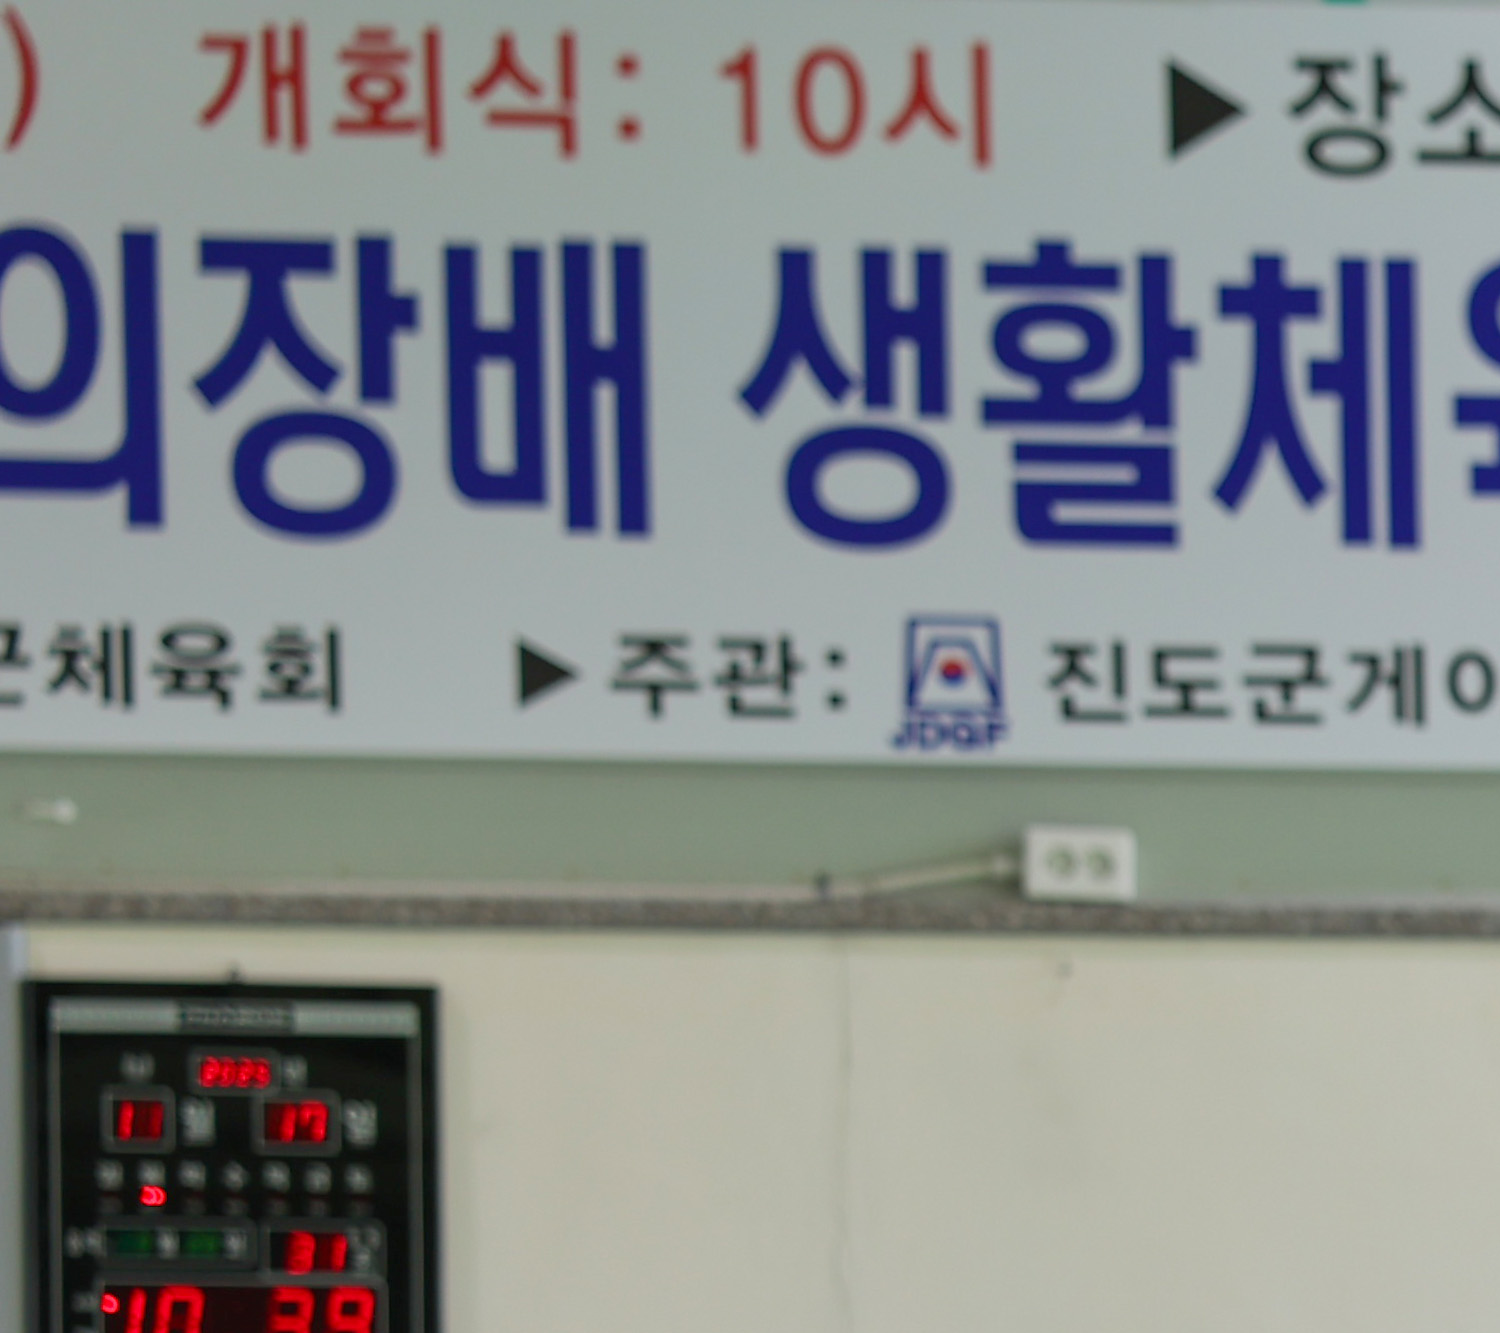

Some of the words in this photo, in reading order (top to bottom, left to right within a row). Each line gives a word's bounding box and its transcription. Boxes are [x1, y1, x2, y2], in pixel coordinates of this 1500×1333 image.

[199, 22, 641, 158] 개회식:
[720, 42, 992, 168] 10시
[610, 634, 847, 720] 주관:
